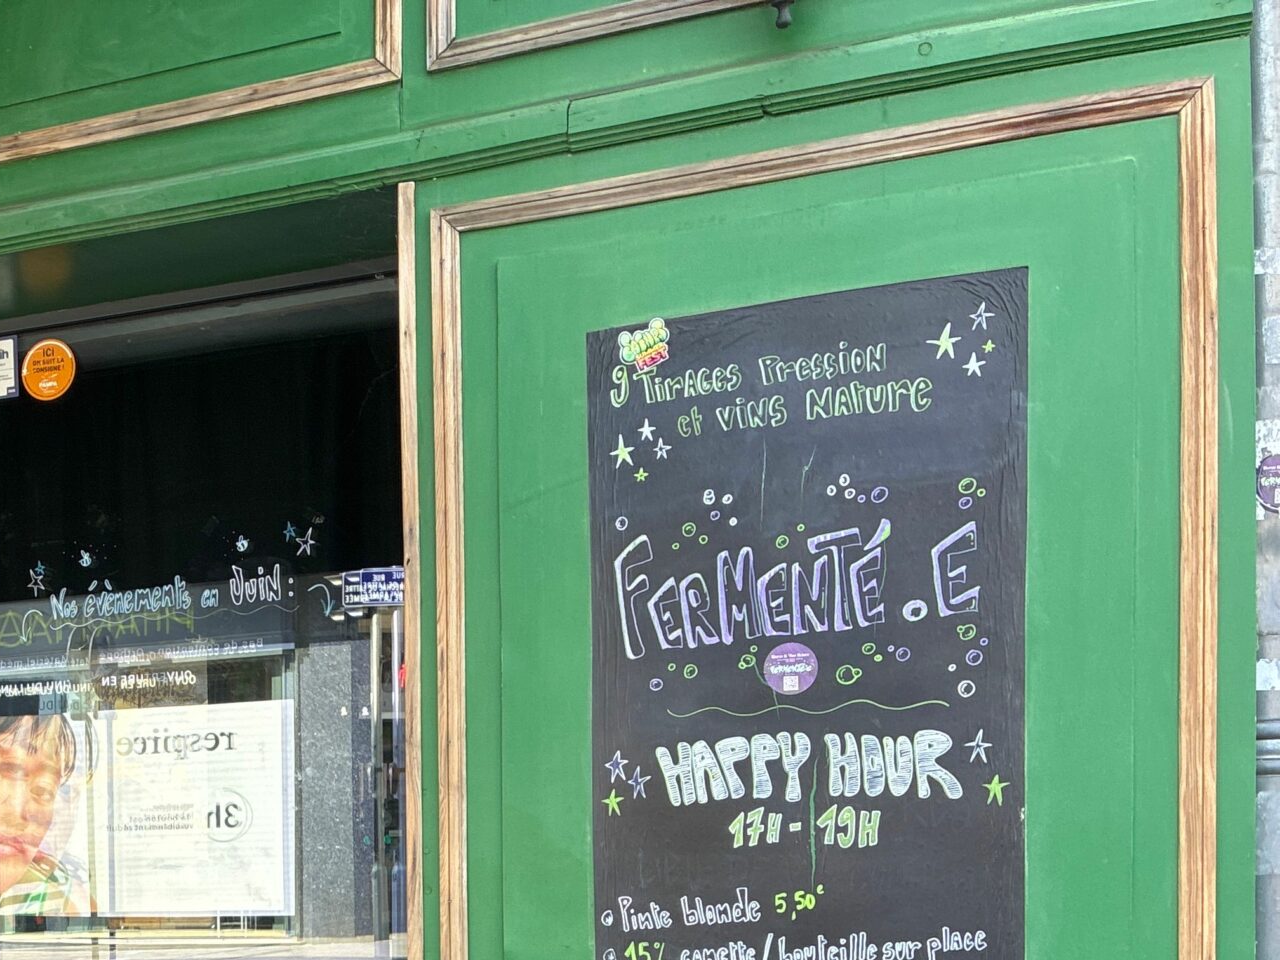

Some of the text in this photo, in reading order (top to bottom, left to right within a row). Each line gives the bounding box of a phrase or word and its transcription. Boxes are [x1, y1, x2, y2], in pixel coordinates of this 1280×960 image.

[42, 348, 54, 357] ICI
[610, 365, 629, 408] 9
[50, 588, 78, 621] Nos
[201, 586, 219, 608] en
[655, 729, 964, 806] HAPPY HOUR
[728, 806, 784, 849] 17H
[817, 808, 882, 849] 19H
[618, 895, 673, 932] Pinte
[680, 887, 762, 926] blonde
